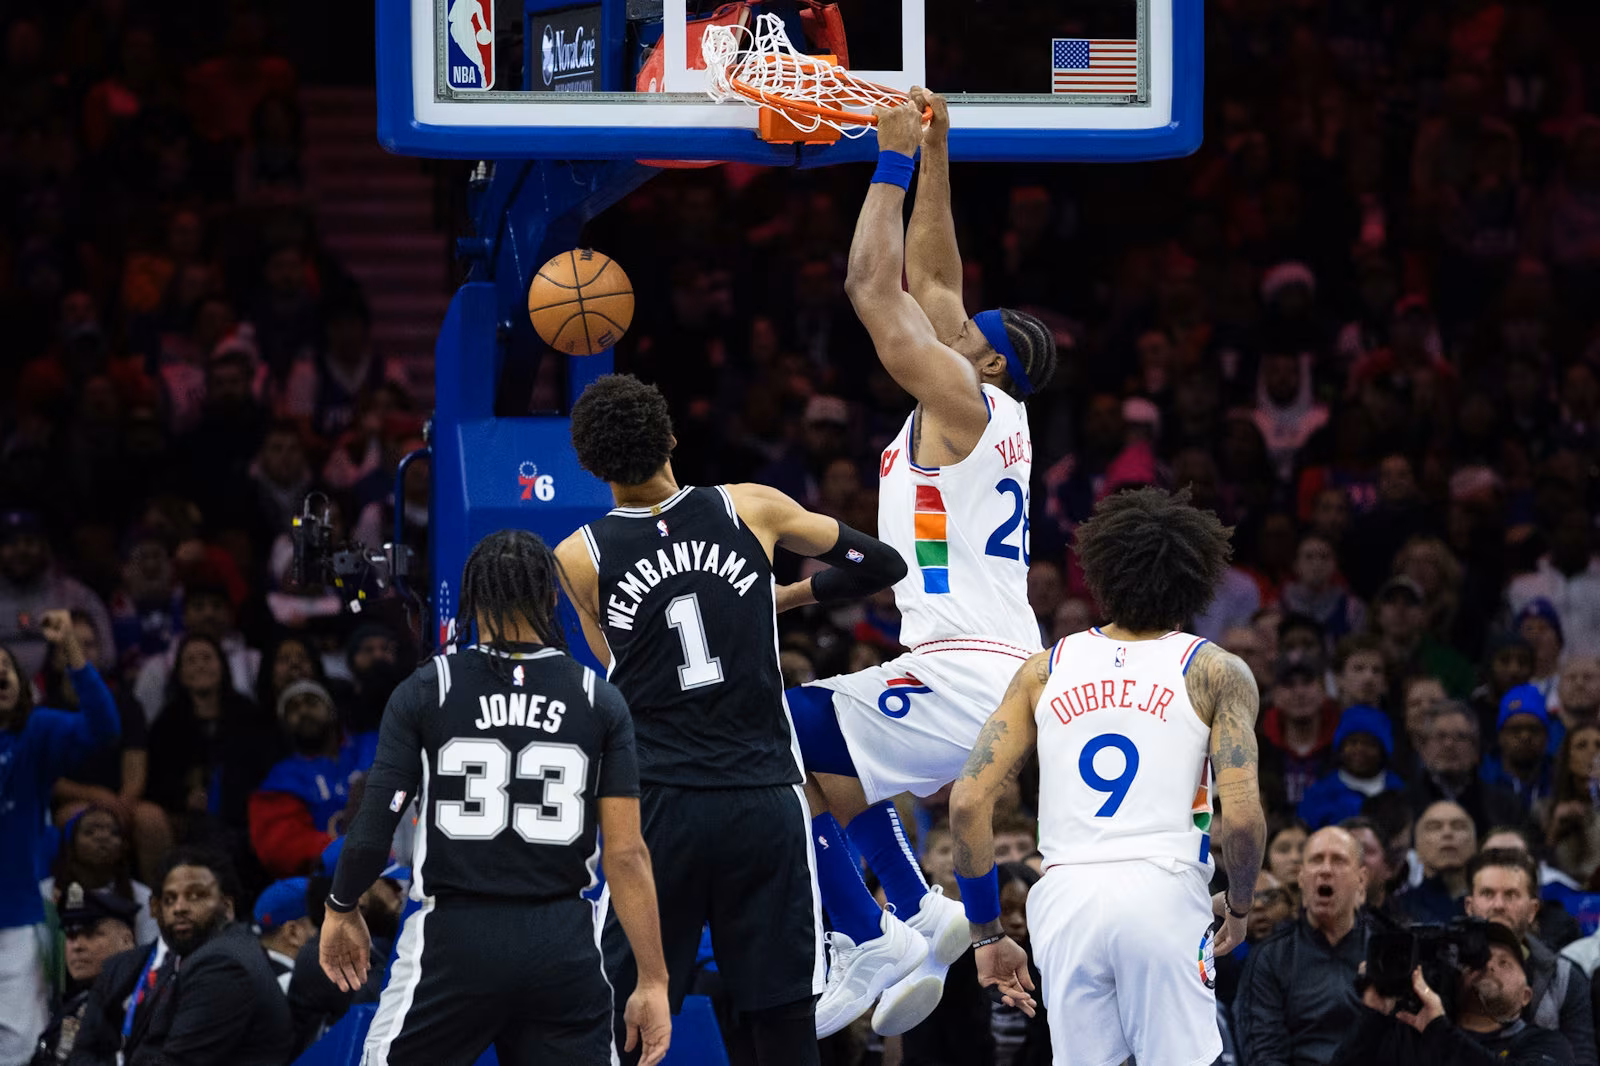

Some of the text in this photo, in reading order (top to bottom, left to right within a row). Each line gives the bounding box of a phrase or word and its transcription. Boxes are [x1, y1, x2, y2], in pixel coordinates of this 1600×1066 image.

[553, 26, 595, 72] NovaCare
[453, 66, 476, 84] NBA
[518, 475, 555, 501] 76
[607, 540, 759, 631] WEMBANYAMA
[665, 592, 725, 691] 1
[475, 693, 566, 734] JONES
[1050, 679, 1175, 725] OUBRE JR.
[435, 737, 589, 846] 33
[1078, 733, 1140, 817] 9
